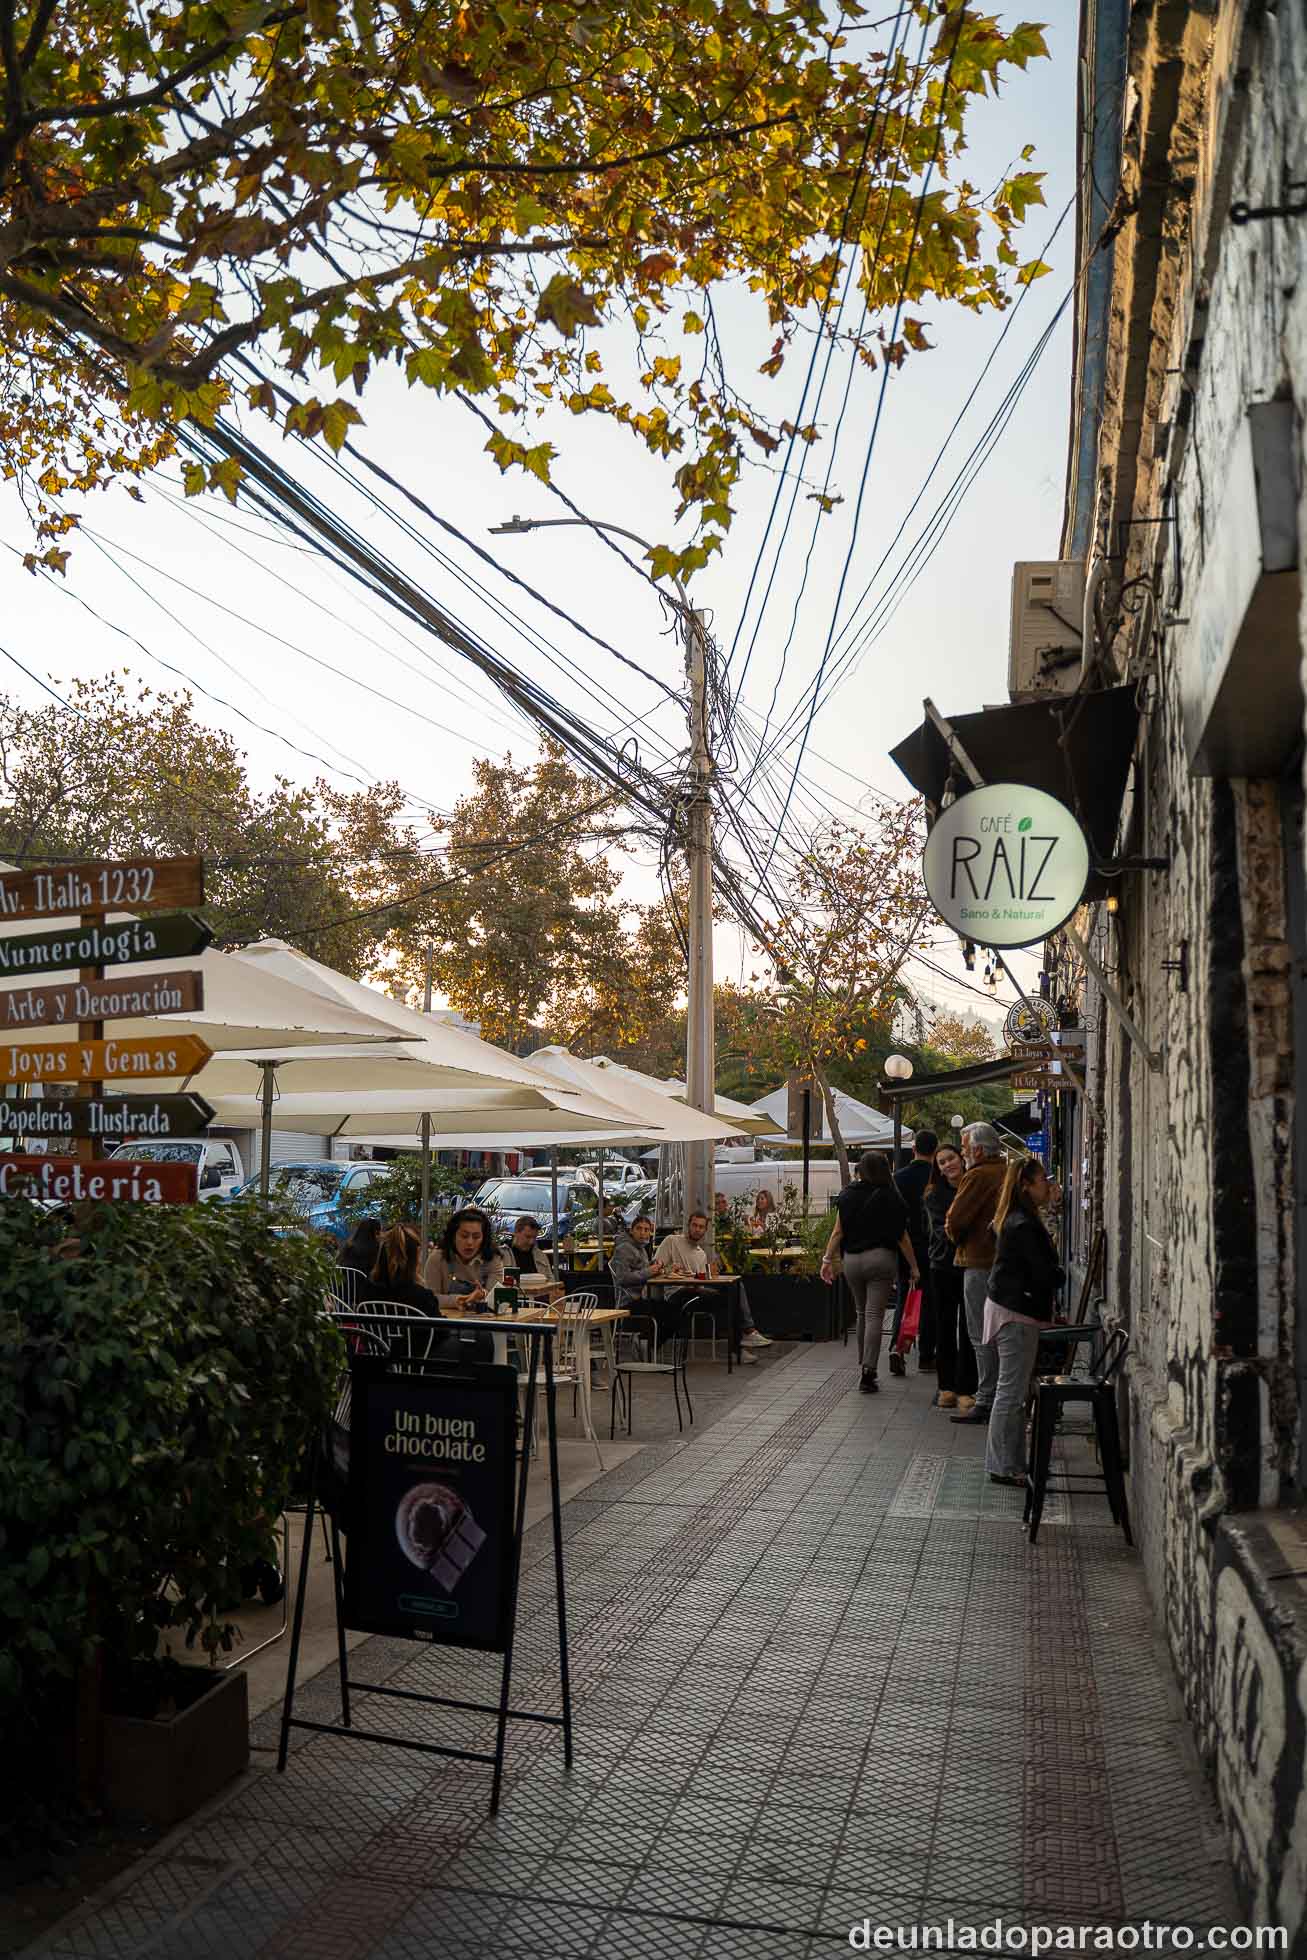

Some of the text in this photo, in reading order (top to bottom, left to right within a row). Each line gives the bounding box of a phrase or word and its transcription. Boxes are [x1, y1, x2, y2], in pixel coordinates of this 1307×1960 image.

[980, 814, 1013, 833] CAFÉ
[0, 867, 155, 913] Av. Italia 1232
[959, 908, 1045, 920] Sano & Natural
[0, 921, 157, 968] Numerología
[7, 980, 183, 1022] Arte y Decoración
[9, 1042, 178, 1079] Joyas y Gemas
[0, 1101, 170, 1136] Papelería Ilustrada
[0, 1162, 163, 1202] Cafetería
[394, 1410, 475, 1440] Un buen
[384, 1432, 486, 1463] chocolate
